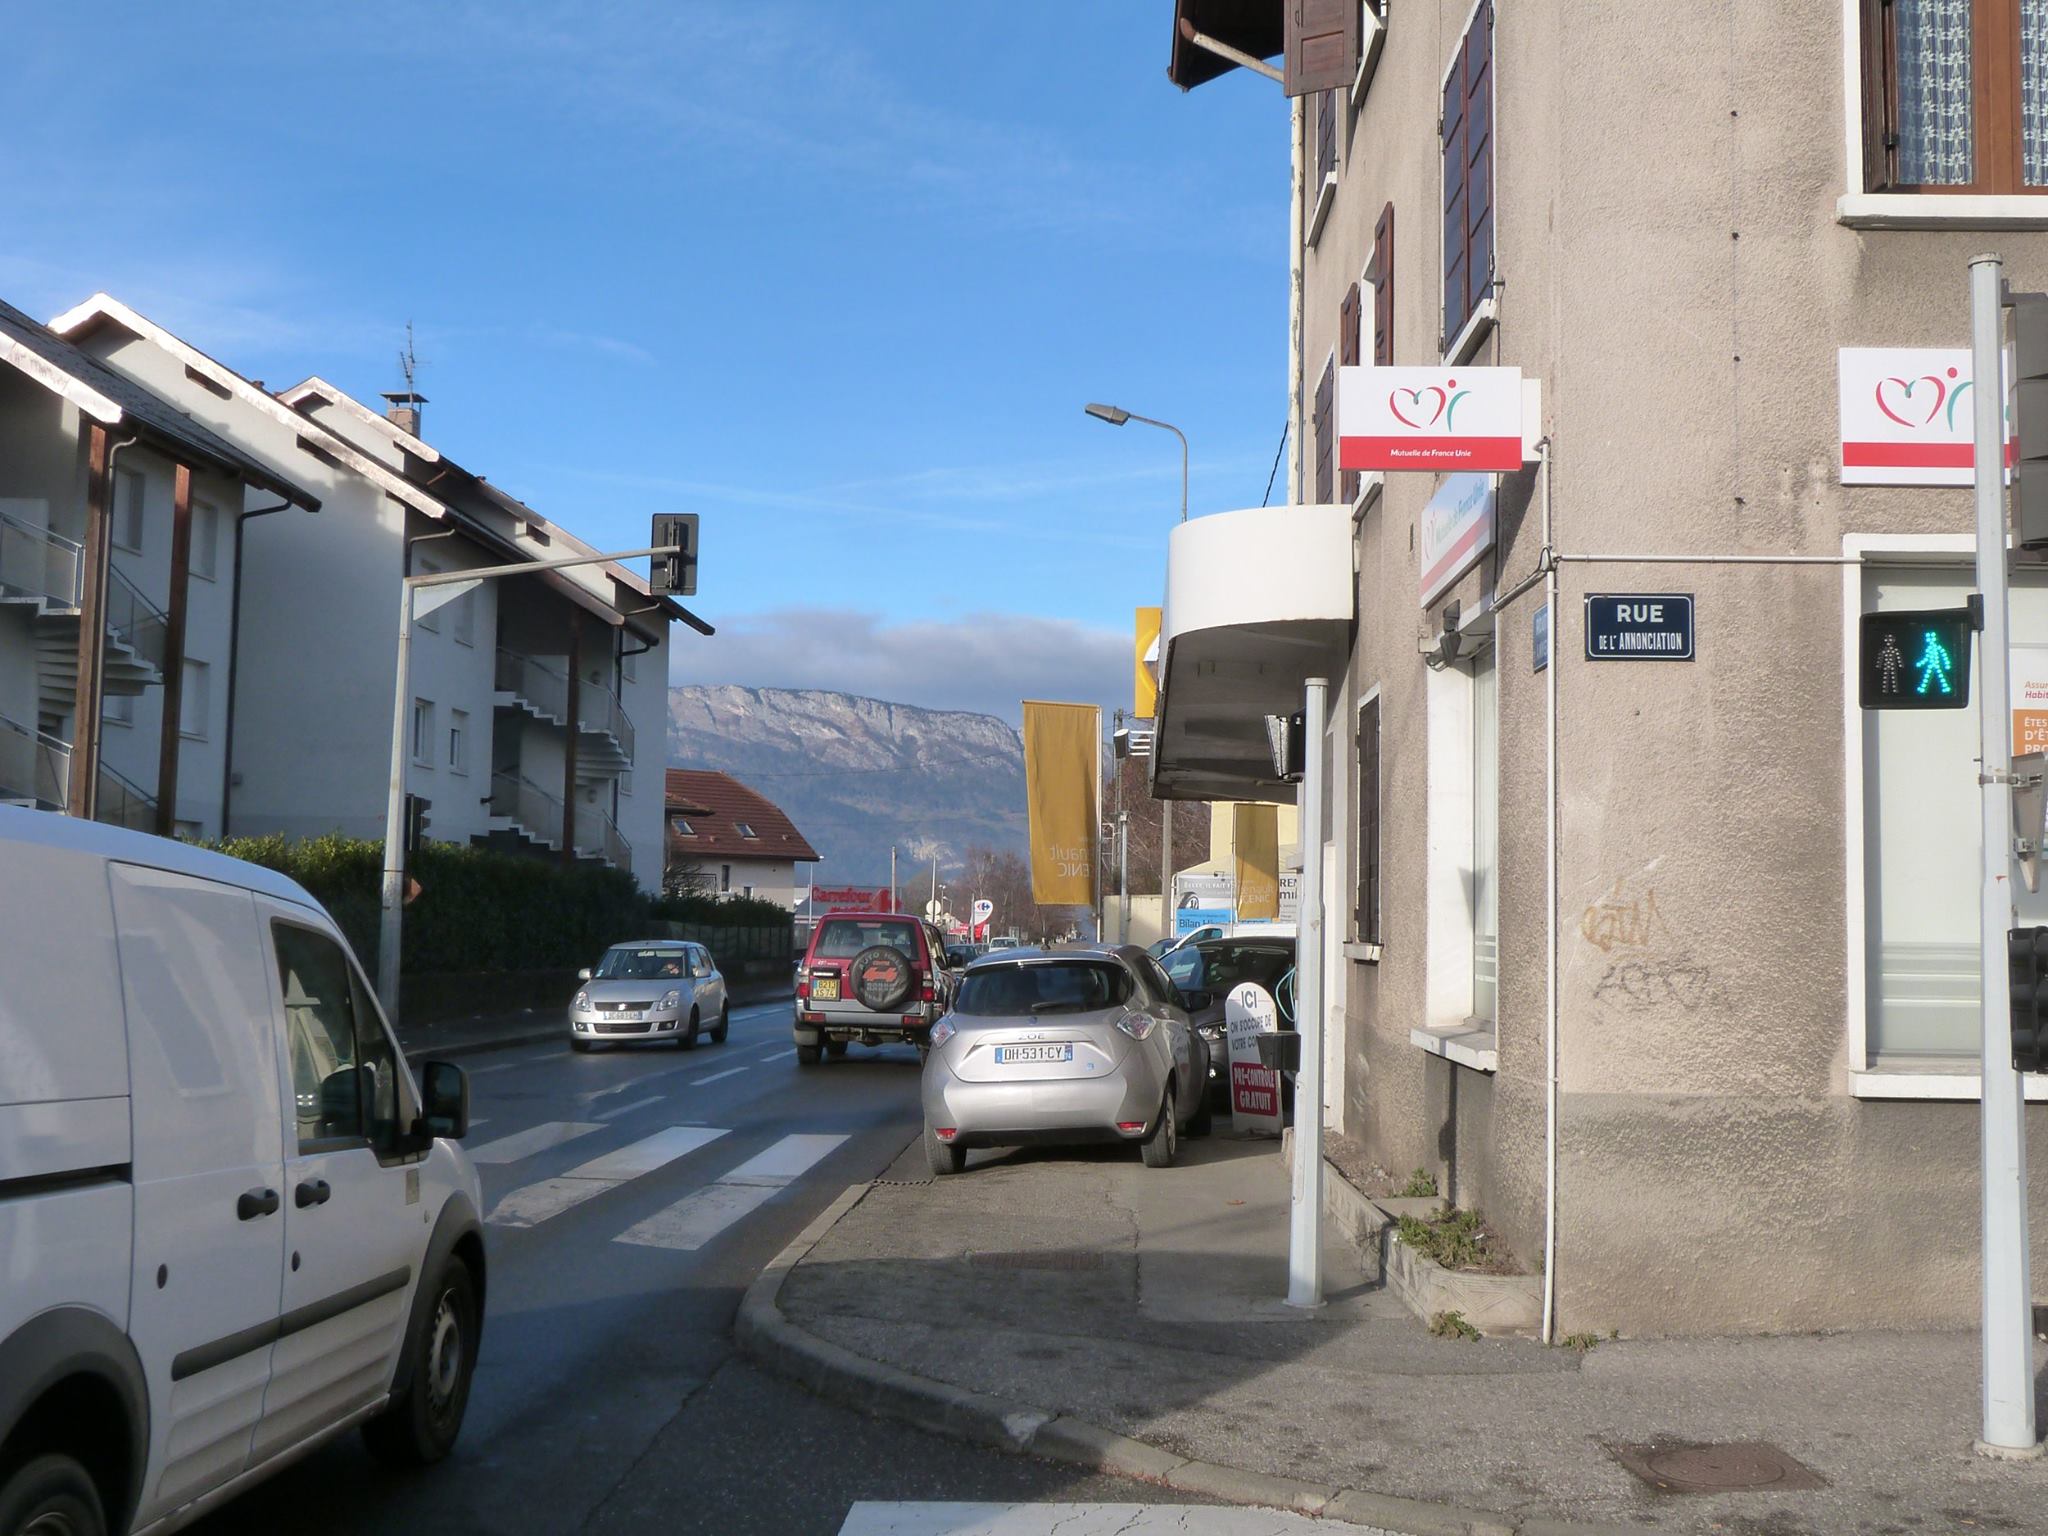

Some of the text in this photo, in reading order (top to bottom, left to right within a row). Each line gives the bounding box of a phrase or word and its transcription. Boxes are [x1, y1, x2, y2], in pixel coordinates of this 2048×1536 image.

[1617, 604, 1664, 622] RUE
[1599, 635, 1607, 650] DE
[1619, 632, 1682, 650] ANNONCIATION
[1179, 919, 1201, 929] Bilan
[1241, 990, 1258, 1009] ICI
[1231, 1021, 1239, 1034] ON
[1264, 1014, 1272, 1027] DE
[1231, 1036, 1246, 1051] VOTRE
[1240, 1090, 1271, 1110] GRATUIT
